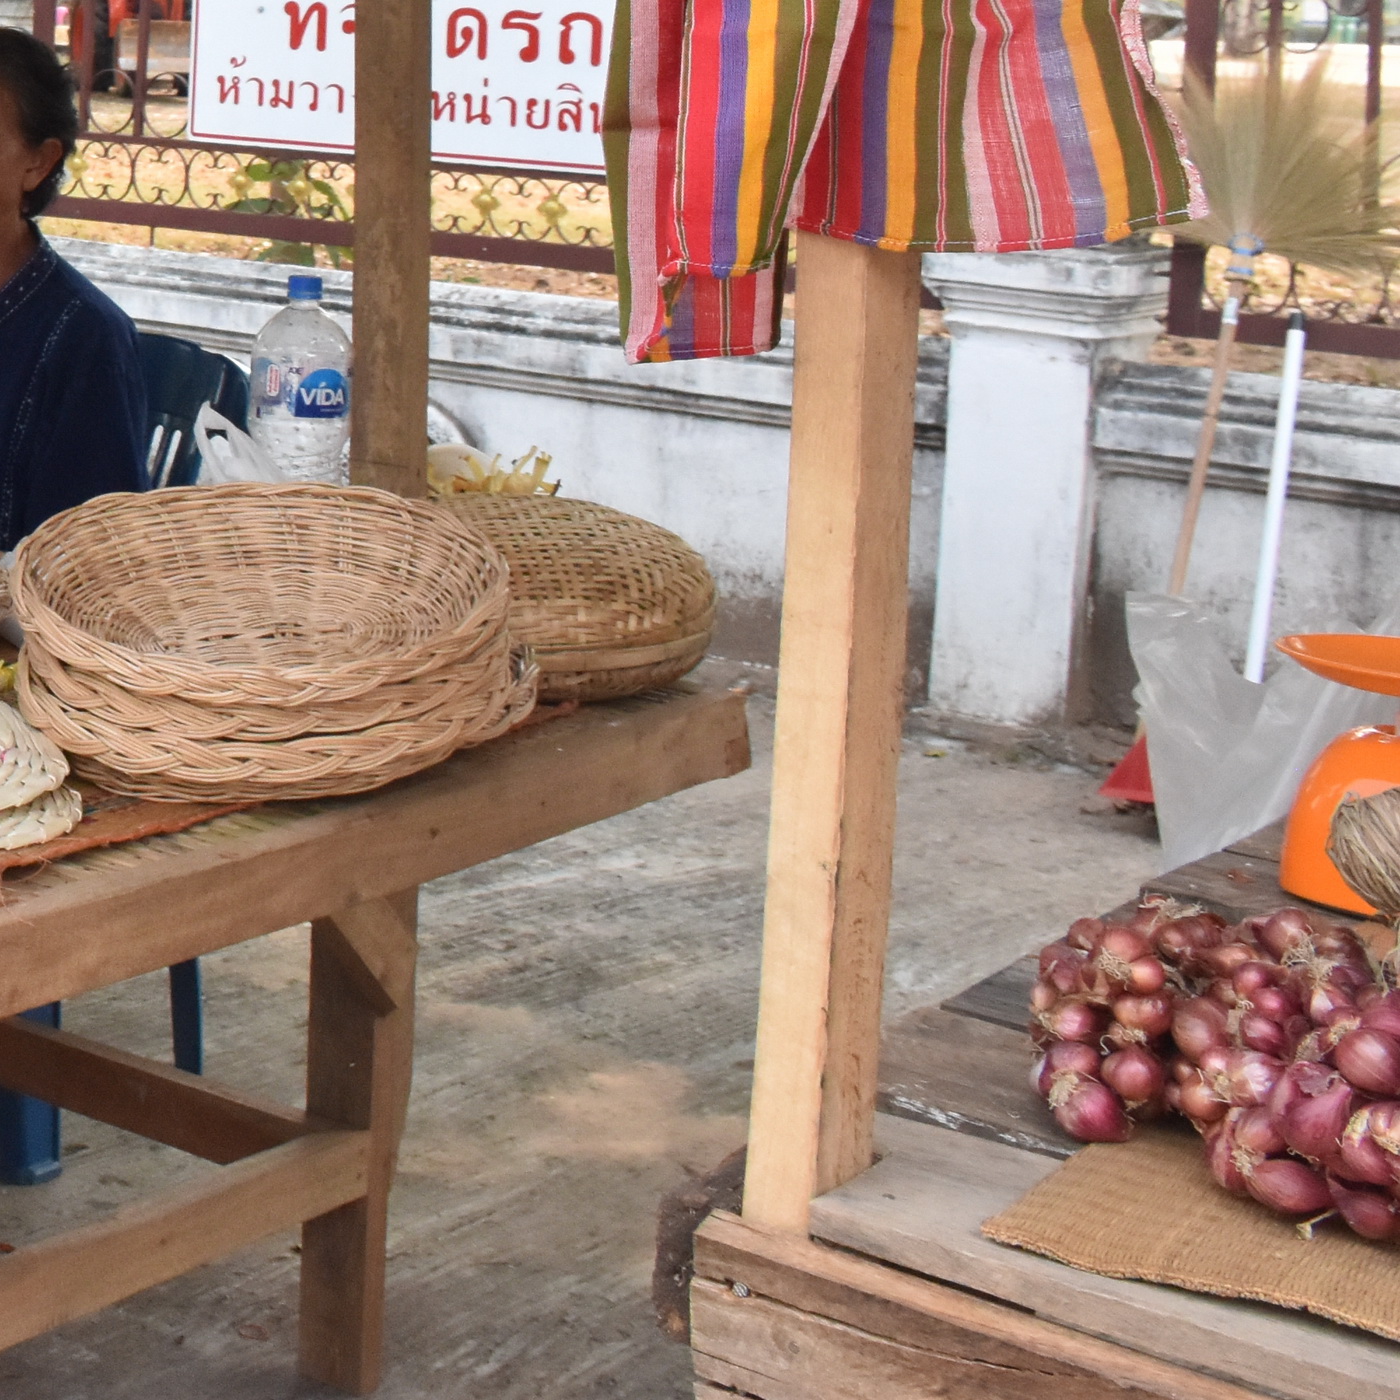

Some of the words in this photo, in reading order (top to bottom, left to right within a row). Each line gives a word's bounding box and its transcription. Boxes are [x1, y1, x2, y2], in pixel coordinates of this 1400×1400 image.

[216, 56, 602, 134] ห้ามวาหน่ายสิ
